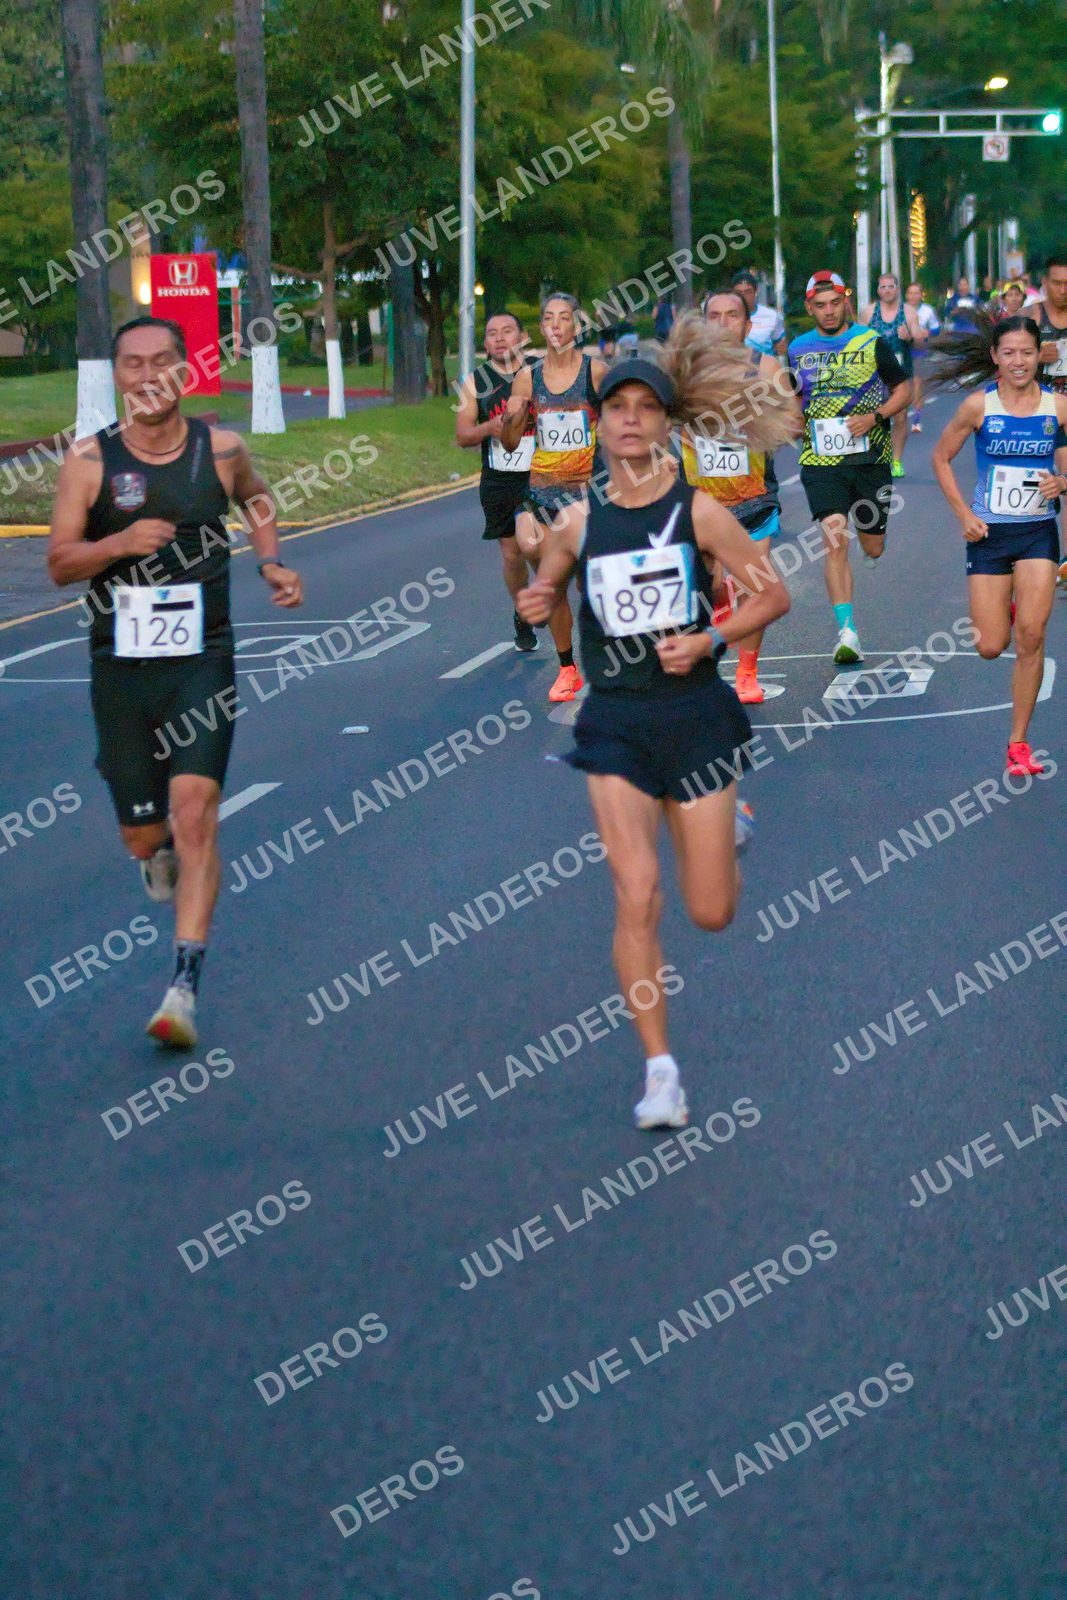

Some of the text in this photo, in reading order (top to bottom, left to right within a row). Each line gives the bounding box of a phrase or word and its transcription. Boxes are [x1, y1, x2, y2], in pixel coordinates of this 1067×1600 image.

[157, 286, 210, 297] HONDA
[539, 427, 584, 447] 1940
[823, 433, 856, 450] 804
[703, 453, 740, 471] 340
[596, 580, 683, 629] 1897
[130, 616, 189, 647] 126
